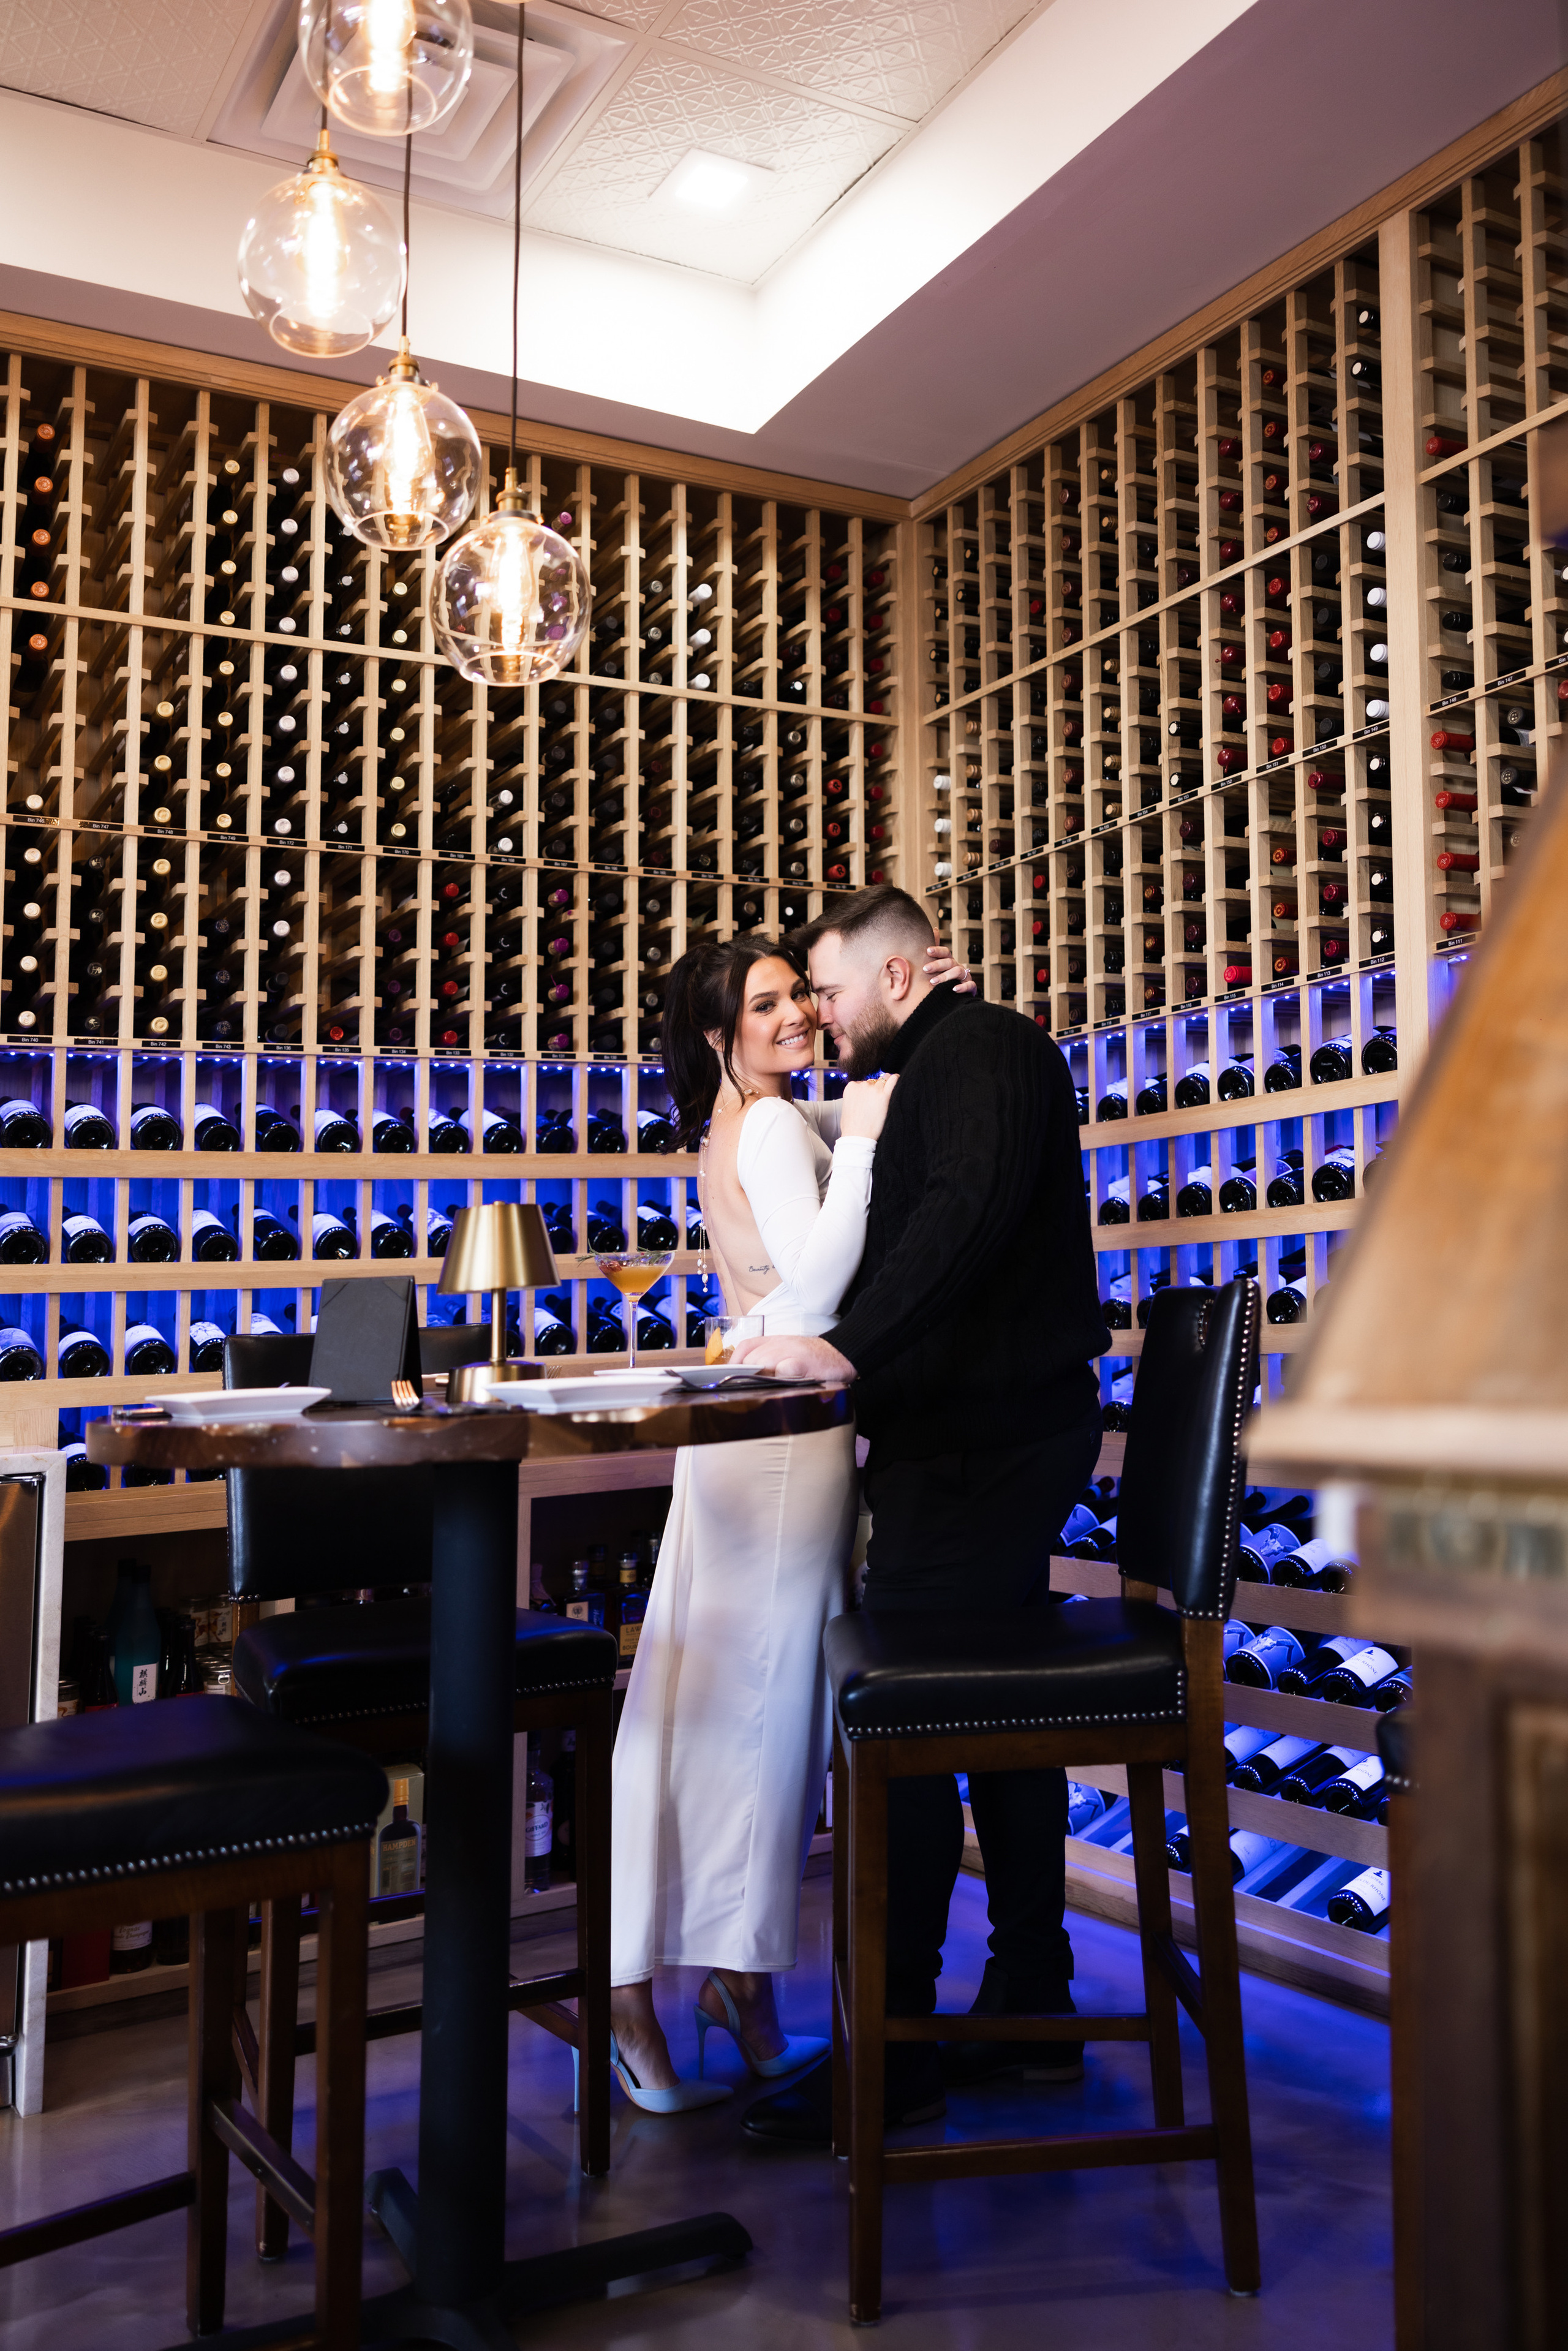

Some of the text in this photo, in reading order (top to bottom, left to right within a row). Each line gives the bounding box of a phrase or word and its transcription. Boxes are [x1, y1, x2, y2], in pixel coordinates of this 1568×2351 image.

[832, 825, 839, 834] R
[837, 866, 844, 875] R
[748, 1265, 770, 1275] Beauty
[526, 1821, 548, 1833] GIFFARD
[383, 1839, 415, 1852] HAMPDEN
